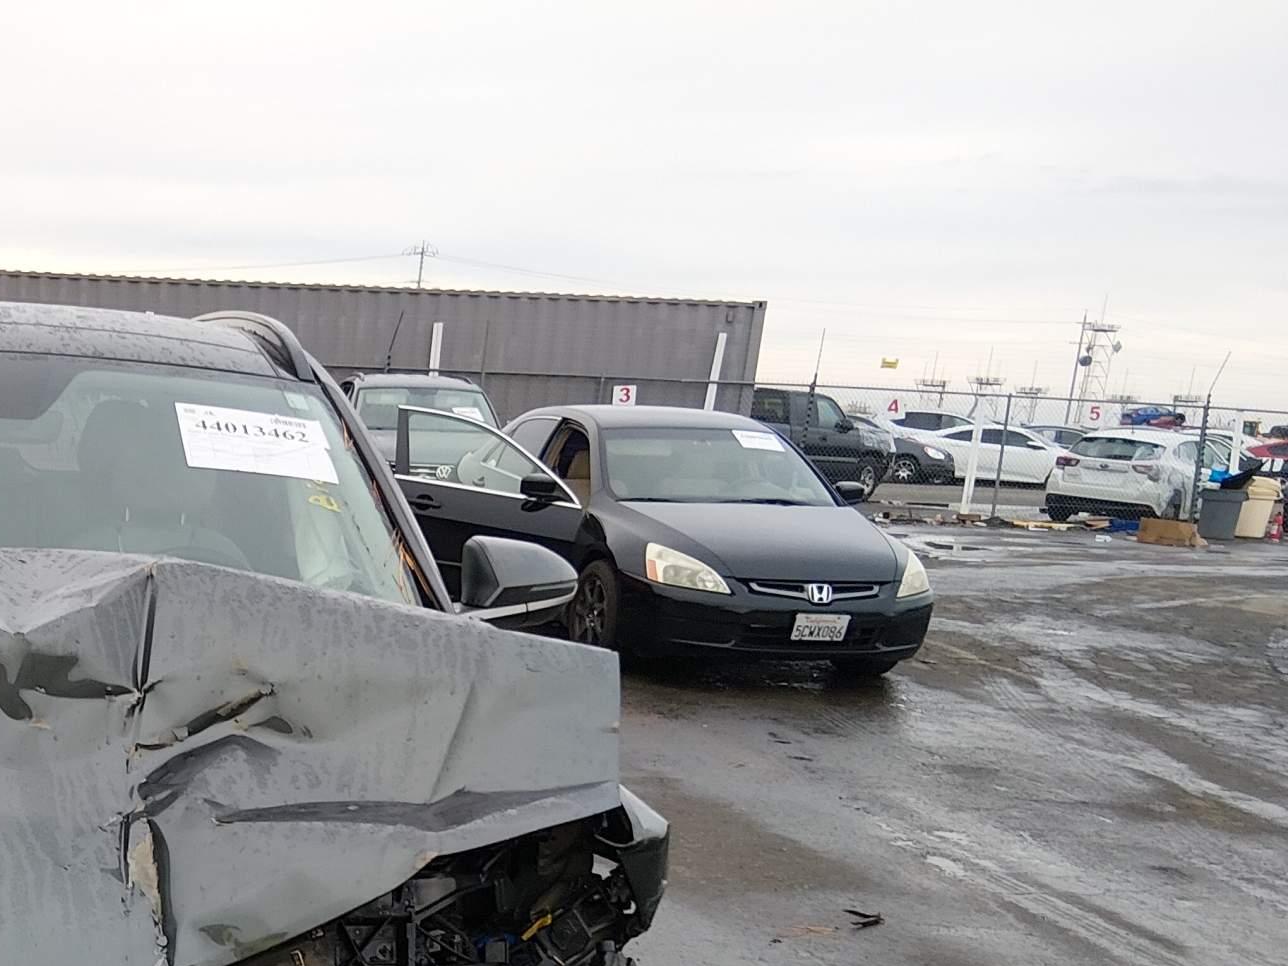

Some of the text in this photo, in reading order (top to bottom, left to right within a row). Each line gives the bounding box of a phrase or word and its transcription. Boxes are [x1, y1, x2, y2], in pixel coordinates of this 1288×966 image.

[618, 387, 631, 403] 3
[887, 399, 899, 414] 4
[1089, 406, 1101, 421] 5
[195, 419, 310, 443] 44013462
